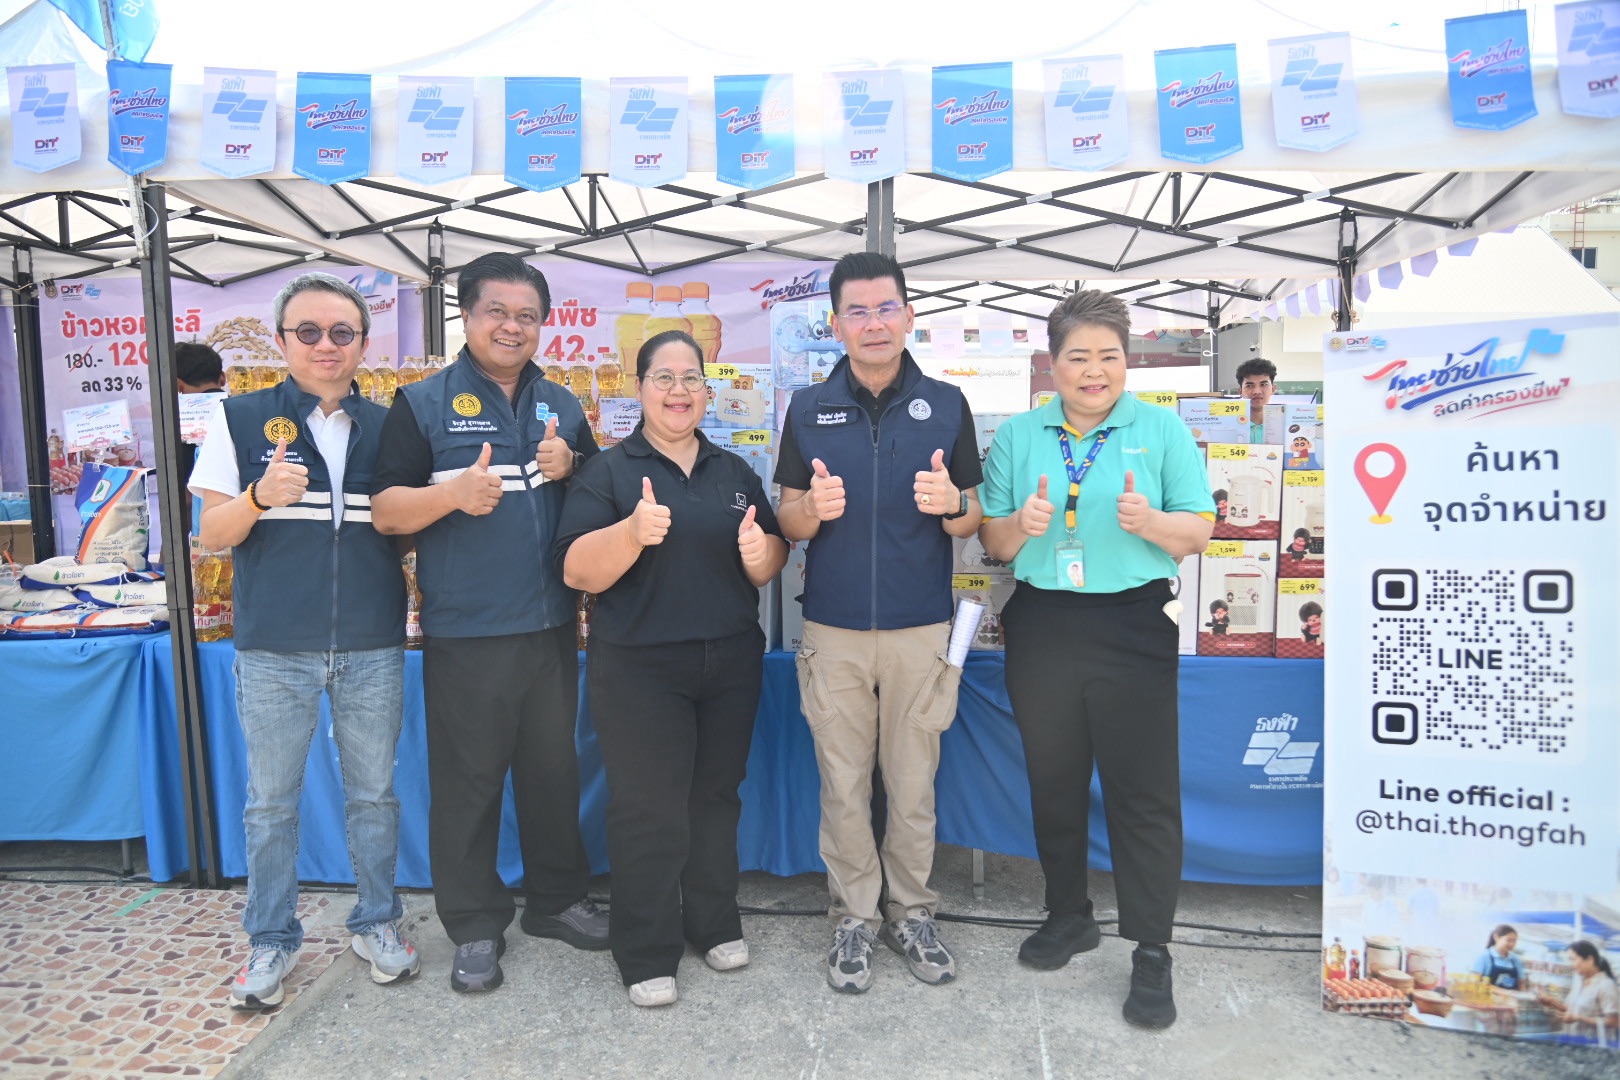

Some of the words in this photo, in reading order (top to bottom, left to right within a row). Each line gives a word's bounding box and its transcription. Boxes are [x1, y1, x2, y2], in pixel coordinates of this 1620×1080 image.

[718, 368, 735, 376] 399
[1362, 336, 1533, 410] ไทยช่วยไทย
[81, 380, 101, 393] ลด
[103, 377, 123, 392] 33
[126, 376, 142, 391] %
[1156, 395, 1173, 403] 599
[1434, 378, 1571, 417] ลดค่าครองชีพ
[1224, 405, 1240, 413] 299
[748, 434, 765, 442] 499
[1230, 449, 1246, 457] 549
[1467, 441, 1559, 472] ค้นหา
[1423, 489, 1606, 532] จุดจำหน่าย
[968, 579, 985, 587] 399
[1299, 583, 1316, 591] 699
[1438, 648, 1502, 670] LINE
[1255, 712, 1299, 731] ธงฟ้า
[1379, 778, 1440, 803] Line
[1447, 785, 1554, 811] official
[1562, 797, 1570, 812] :
[1356, 808, 1587, 848] @thai.thongfah
